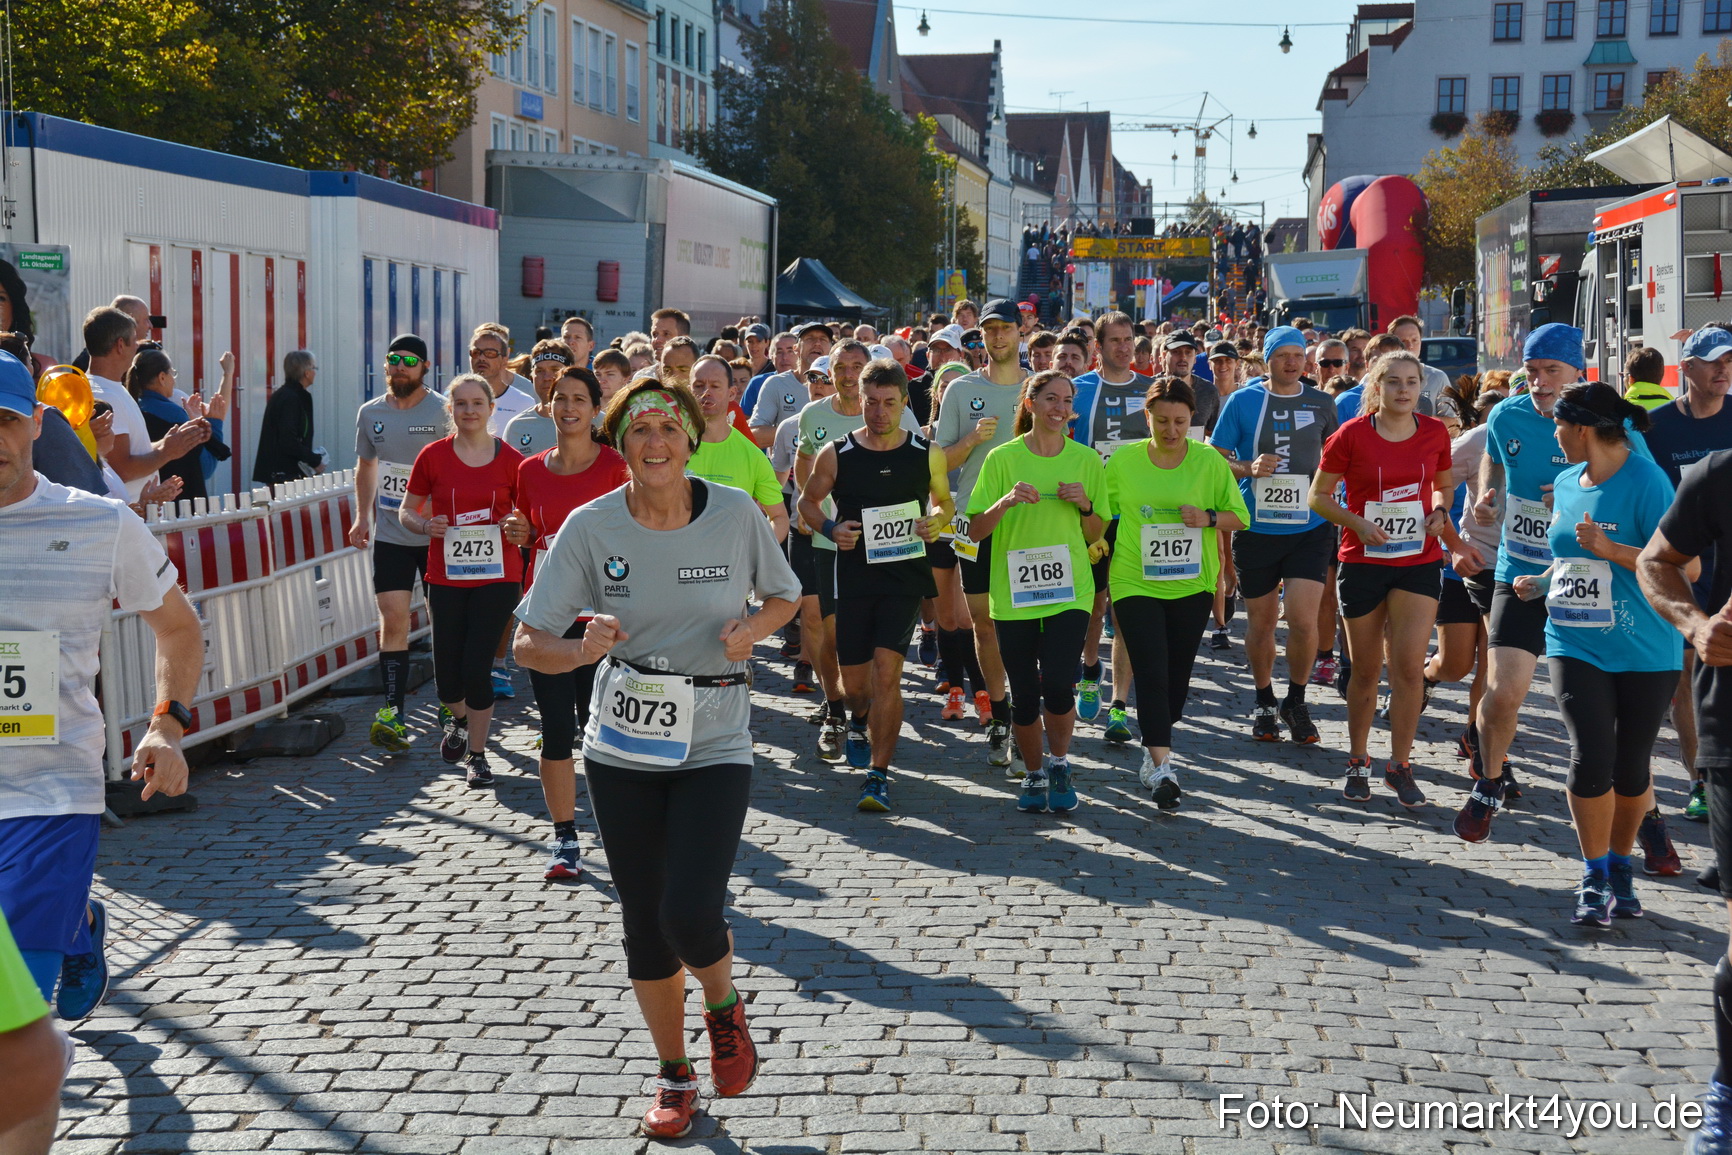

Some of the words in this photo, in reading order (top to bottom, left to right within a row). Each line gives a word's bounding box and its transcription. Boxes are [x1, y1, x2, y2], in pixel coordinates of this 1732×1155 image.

[1118, 242, 1165, 253] START
[1273, 410, 1291, 473] MATEC
[1264, 488, 1300, 503] 2281
[1392, 489, 1409, 497] DEHN
[879, 509, 905, 518] BOCK
[1273, 511, 1292, 519] Georg
[872, 518, 913, 540] 2027
[1374, 517, 1417, 534] 2472
[453, 540, 494, 557] 2473
[874, 545, 918, 557] Hans-Jürgen
[1150, 539, 1193, 557] 2167
[1523, 546, 1544, 558] Frank
[462, 566, 486, 574] Vögele
[679, 566, 729, 579] BOCK
[1018, 562, 1064, 583] 2168
[1159, 567, 1185, 575] Larissa
[604, 585, 630, 593] PARTL
[1033, 591, 1055, 600] Maria
[1556, 578, 1600, 599] 2064
[1565, 610, 1589, 620] Gisela
[648, 656, 674, 672] 19.
[0, 665, 26, 699] 5
[384, 660, 400, 702] kalenji
[625, 677, 664, 693] BOCK
[612, 690, 677, 727] 3073
[615, 721, 631, 732] PARTL
[631, 728, 662, 736] Neumarkt
